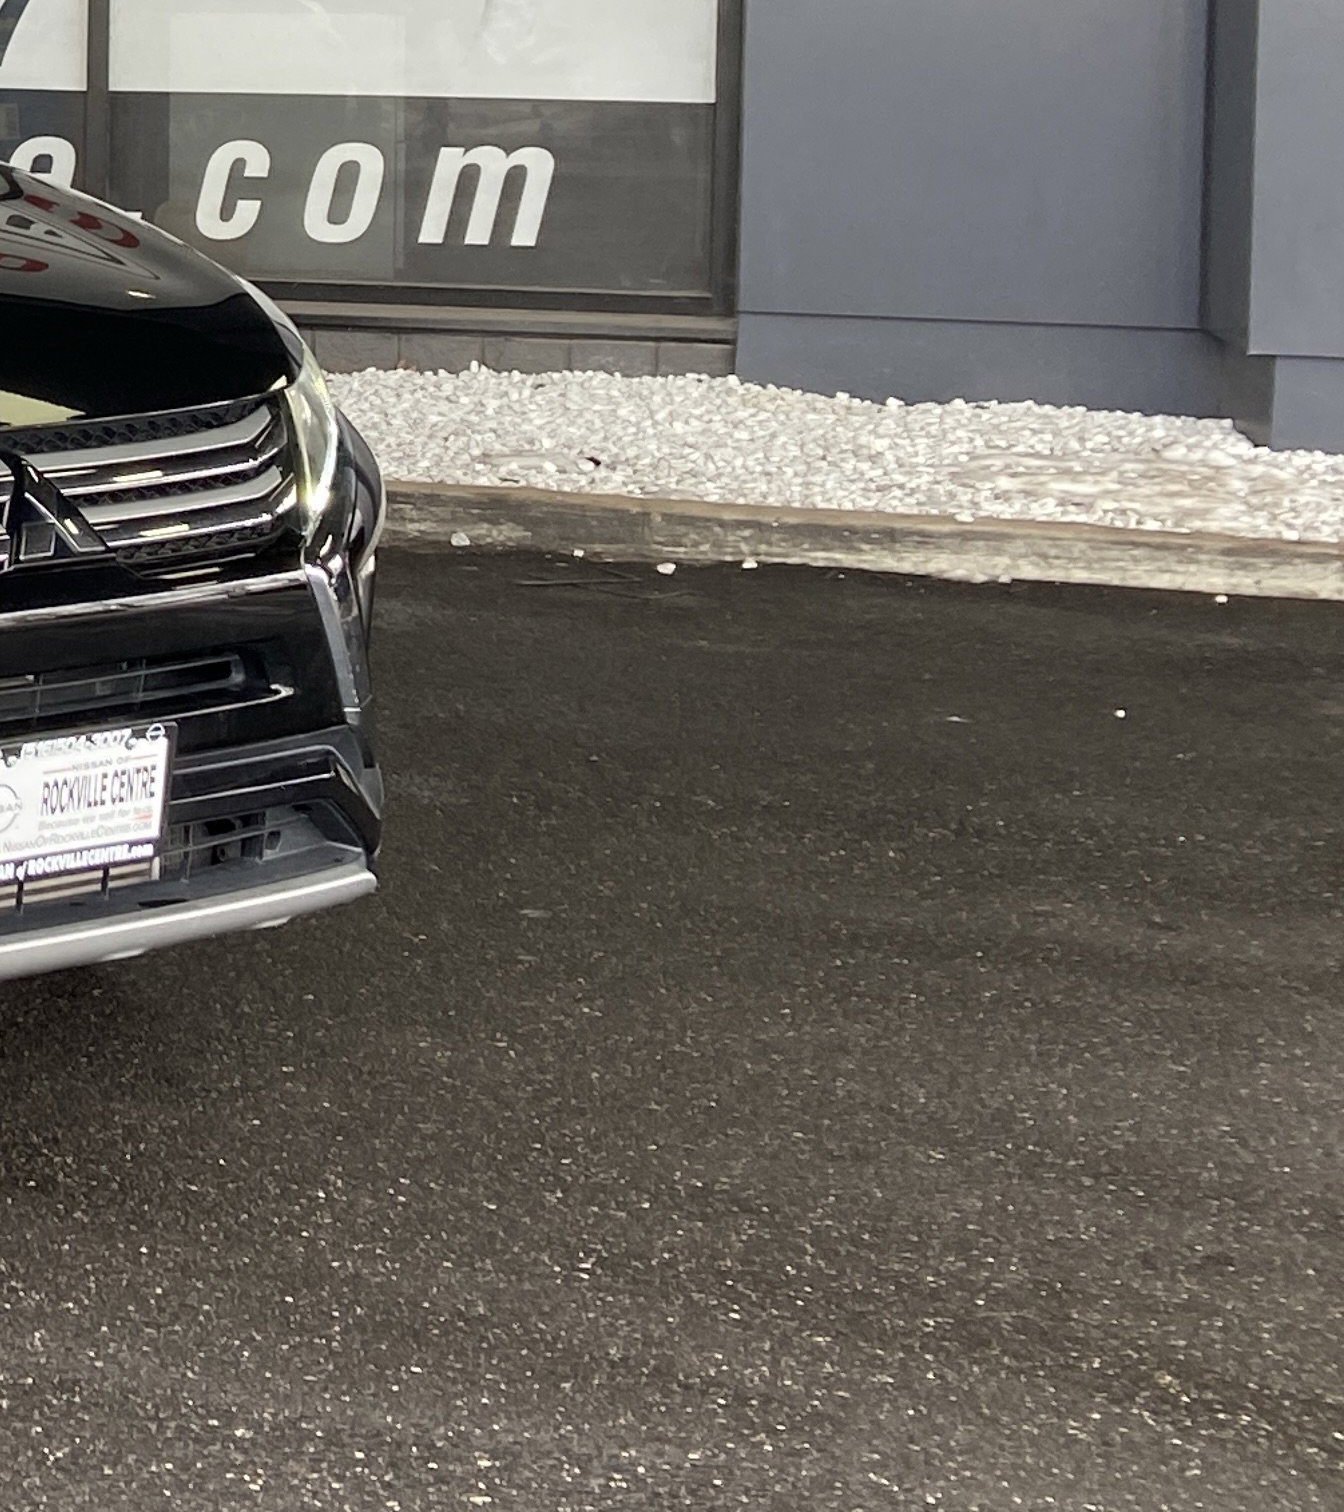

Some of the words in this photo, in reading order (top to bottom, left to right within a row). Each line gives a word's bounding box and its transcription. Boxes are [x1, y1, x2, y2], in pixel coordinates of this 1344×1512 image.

[72, 757, 113, 772] NISSAN
[39, 773, 109, 817] ROCKVILLE
[111, 764, 157, 807] CENTRE
